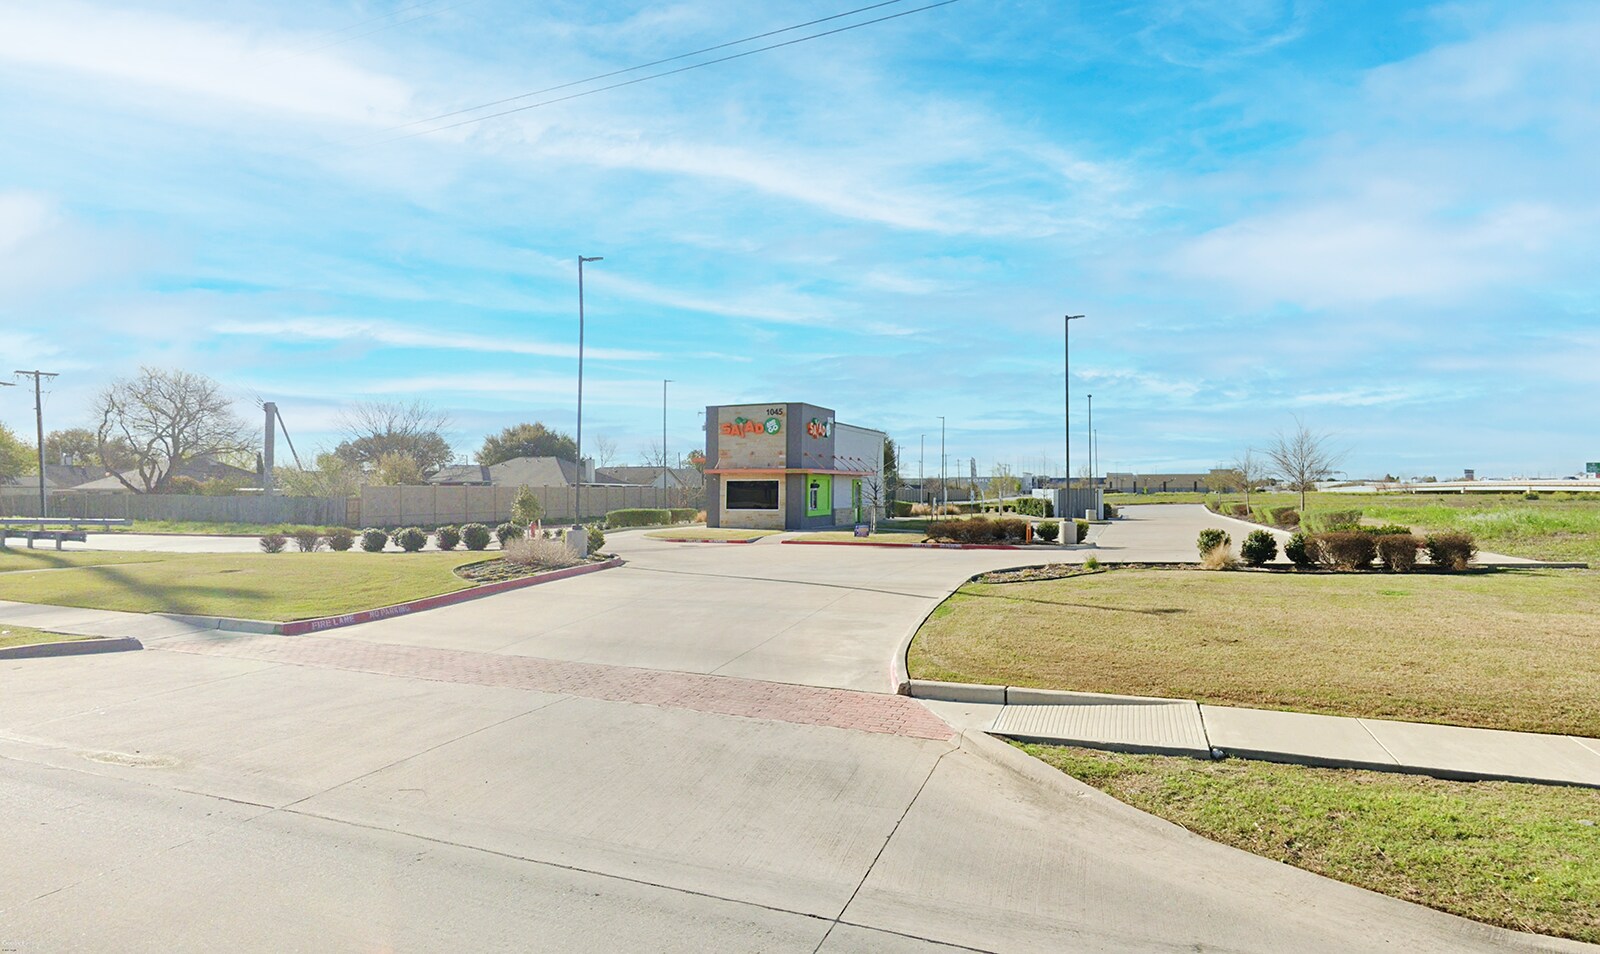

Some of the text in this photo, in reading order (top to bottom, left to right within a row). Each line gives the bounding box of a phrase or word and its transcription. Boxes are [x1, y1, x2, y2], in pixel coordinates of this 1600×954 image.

[766, 408, 783, 416] 1045
[721, 421, 764, 438] SALAD
[312, 620, 332, 630] FIRE
[333, 616, 354, 625] LANE
[380, 605, 410, 615] PARKING
